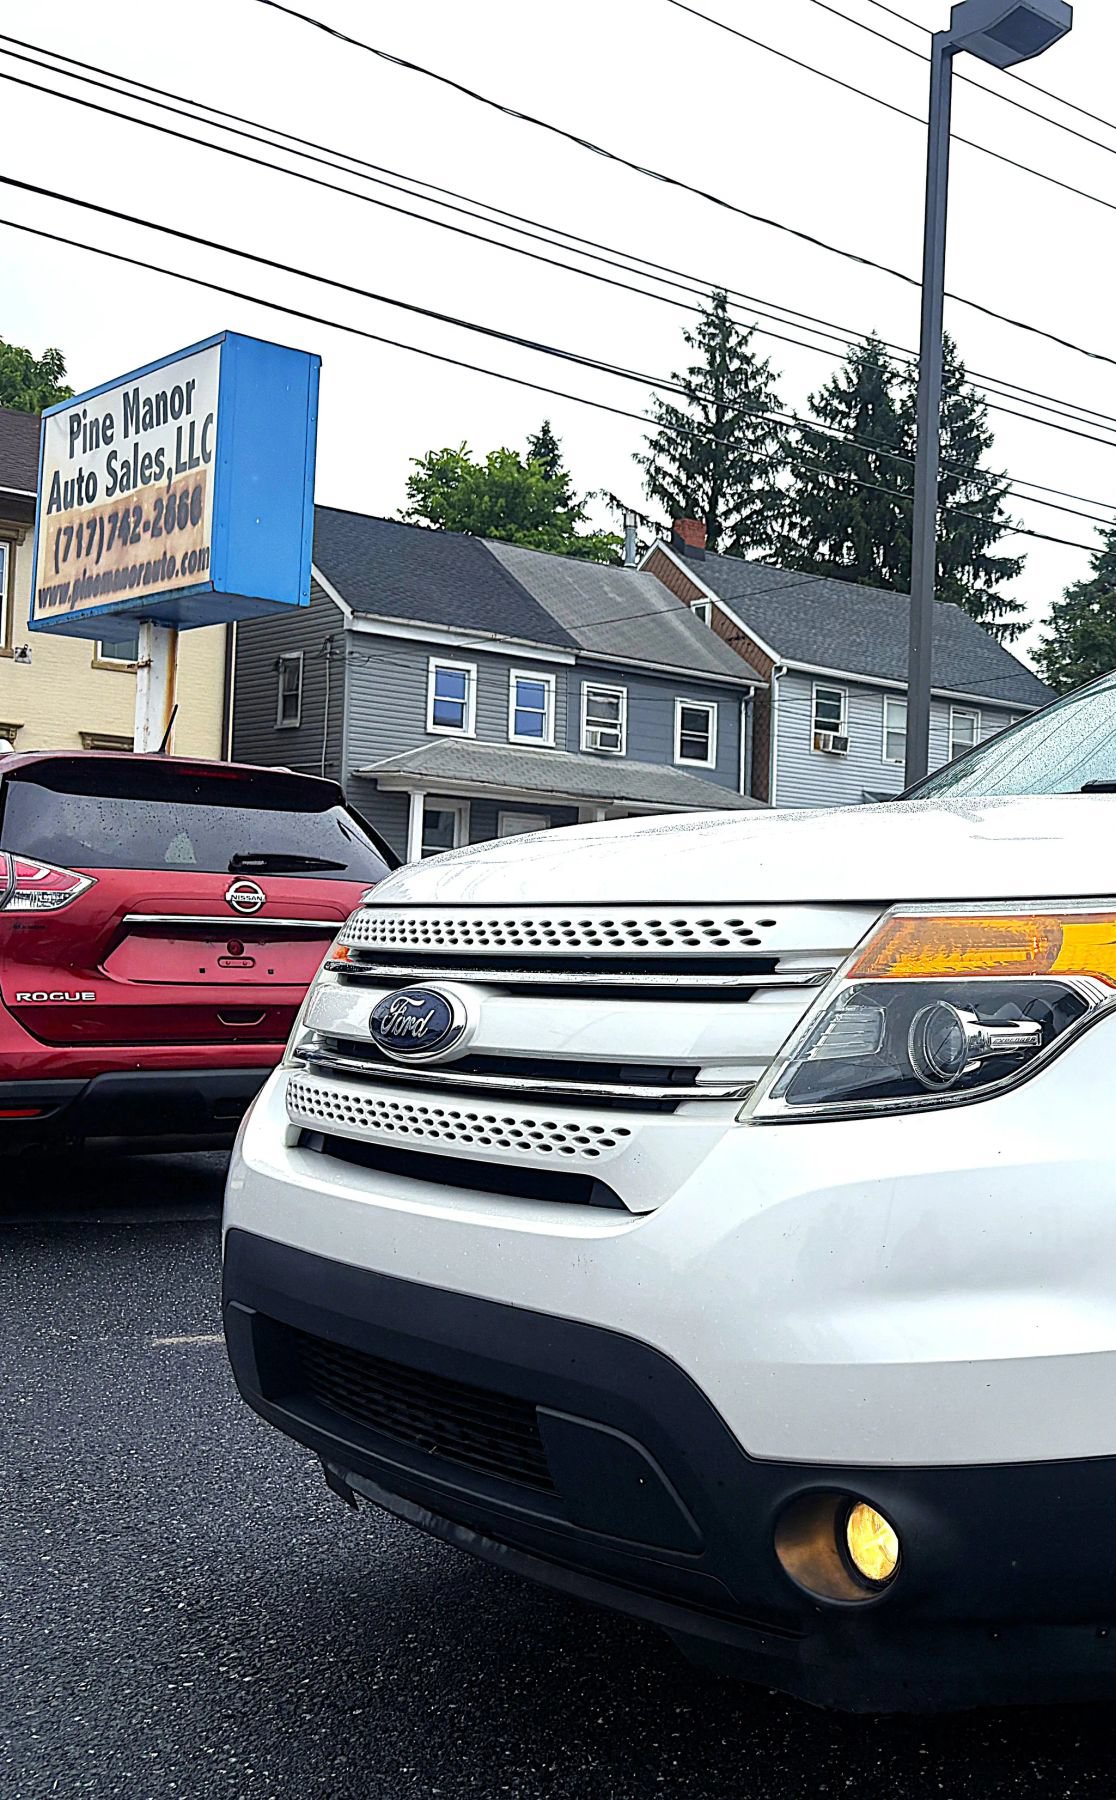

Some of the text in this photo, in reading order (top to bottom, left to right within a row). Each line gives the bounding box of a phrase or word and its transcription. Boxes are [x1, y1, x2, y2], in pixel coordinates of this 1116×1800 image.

[69, 378, 196, 459] Pine Manor
[46, 466, 98, 515] Auto
[16, 991, 96, 1002] ROGUE
[381, 996, 435, 1038] Ford
